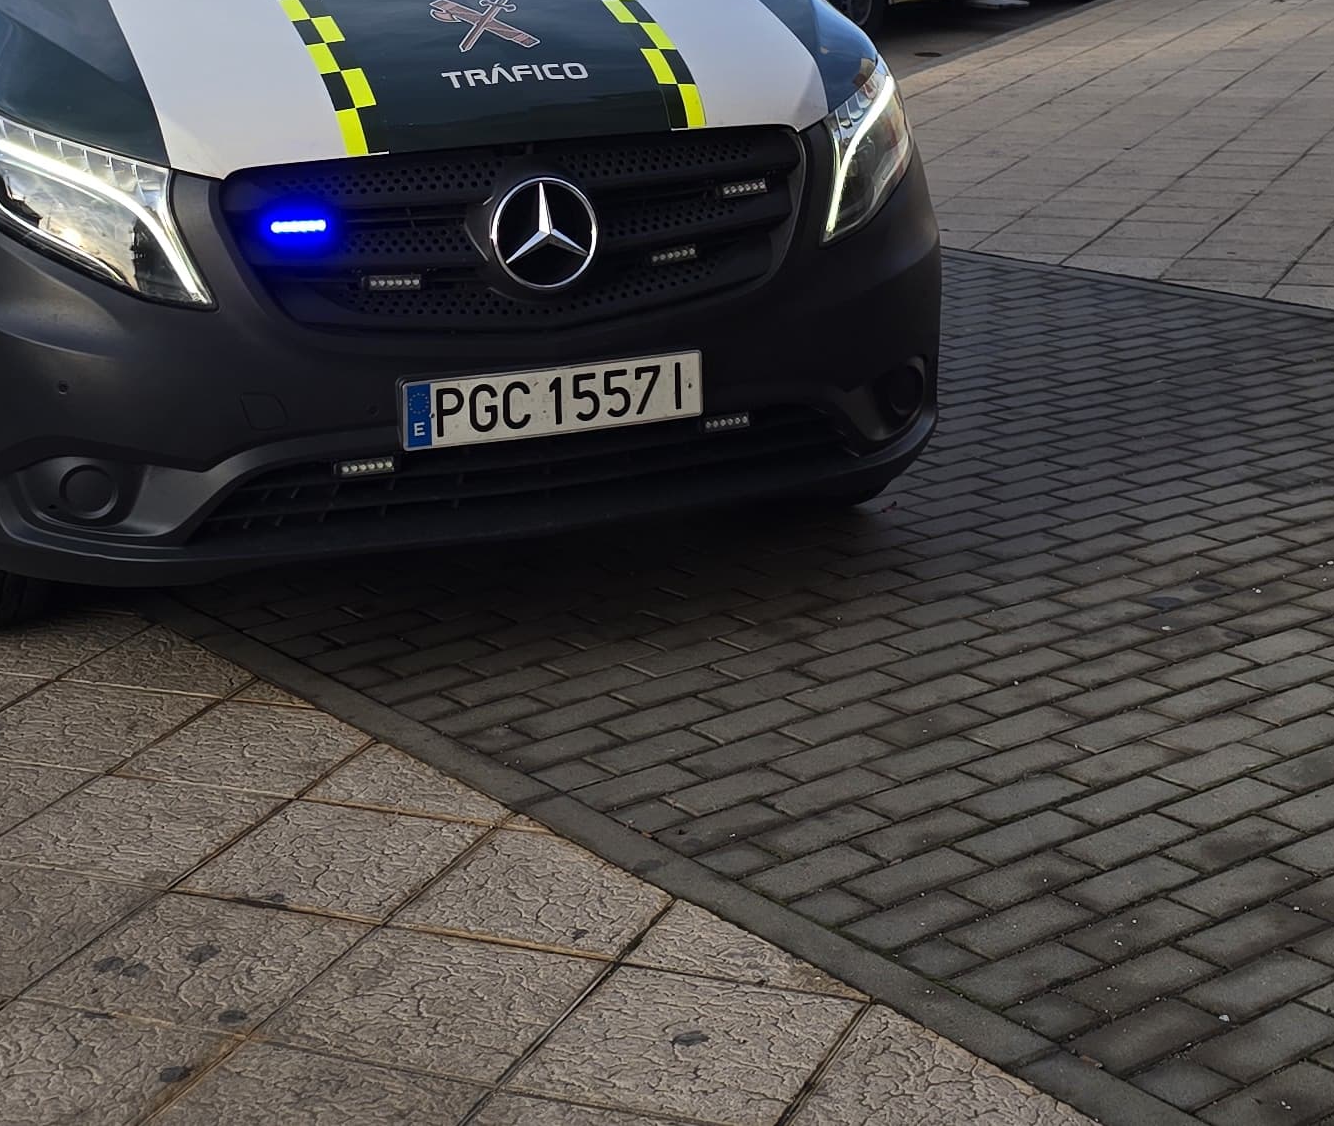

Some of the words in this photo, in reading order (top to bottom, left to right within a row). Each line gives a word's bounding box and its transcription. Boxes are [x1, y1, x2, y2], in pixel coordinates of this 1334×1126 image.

[440, 61, 589, 89] TRÁFICO
[413, 421, 425, 437] E
[435, 380, 532, 438] PGC
